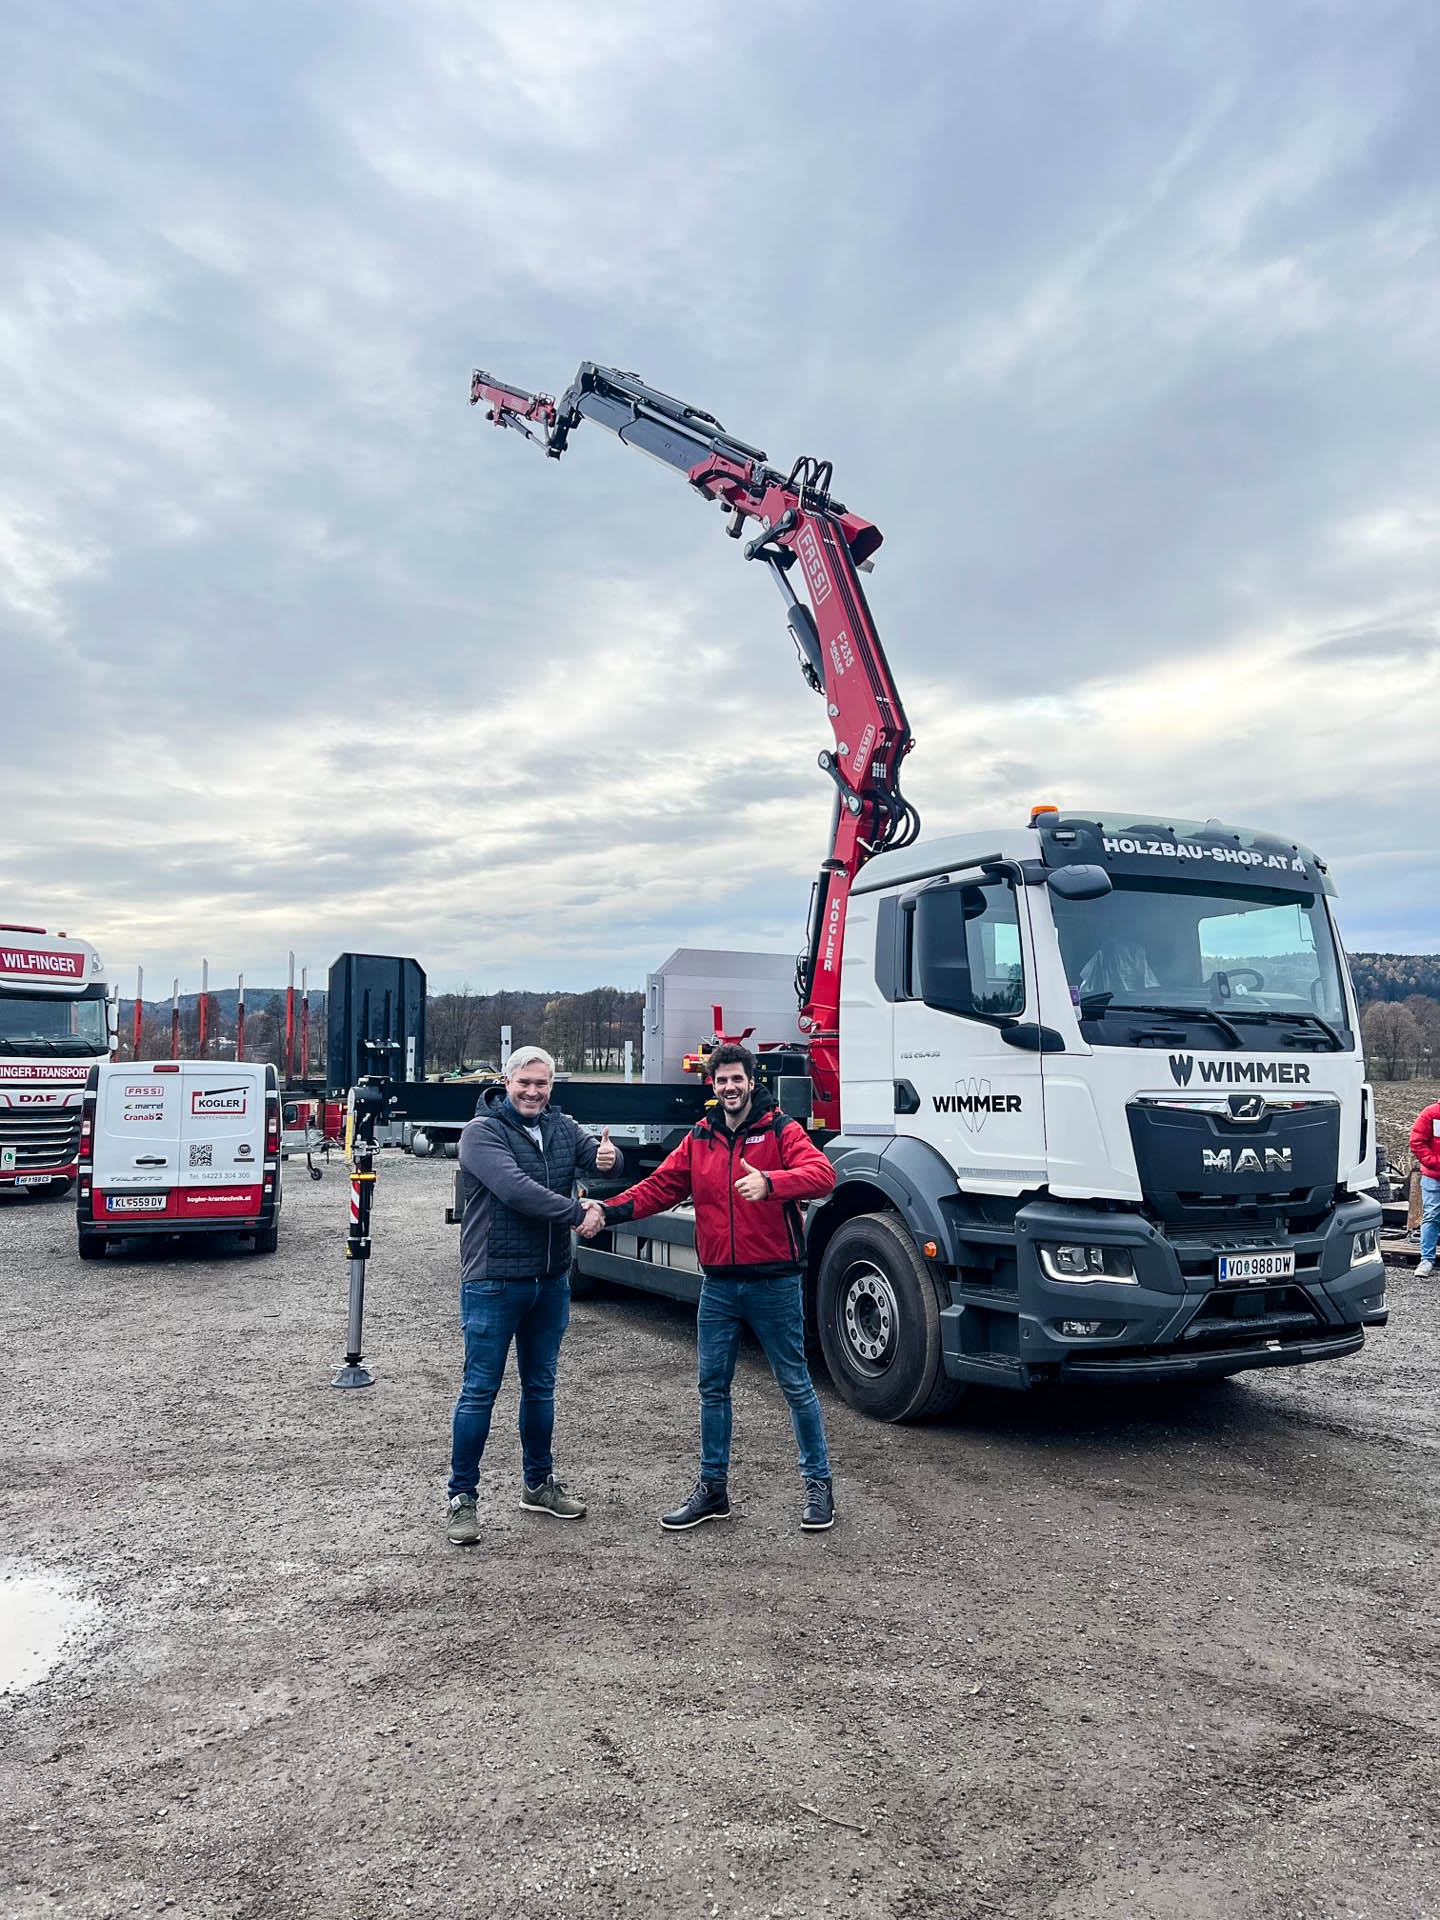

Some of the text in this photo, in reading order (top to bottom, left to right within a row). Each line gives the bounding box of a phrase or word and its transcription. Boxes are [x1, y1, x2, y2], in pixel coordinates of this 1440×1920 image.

[801, 533, 828, 597] FASSI
[830, 639, 845, 675] KOGLER
[836, 631, 855, 668] F235
[855, 727, 874, 769] FASSI
[1102, 838, 1289, 870] HOLZBAU-SHOP.AT
[823, 898, 841, 971] KOGLER
[1, 953, 76, 973] WILFINGER
[1198, 1061, 1311, 1083] WIMMER
[199, 1099, 240, 1107] KOGLER
[932, 1095, 1022, 1113] WIMMER
[1202, 1147, 1292, 1174] MAN
[115, 1198, 126, 1207] KL
[132, 1197, 150, 1207] 559
[186, 1195, 252, 1203] kogler-krantechnik.at
[1228, 1260, 1242, 1276] VO
[1251, 1258, 1273, 1274] 988
[1275, 1256, 1291, 1273] DW
